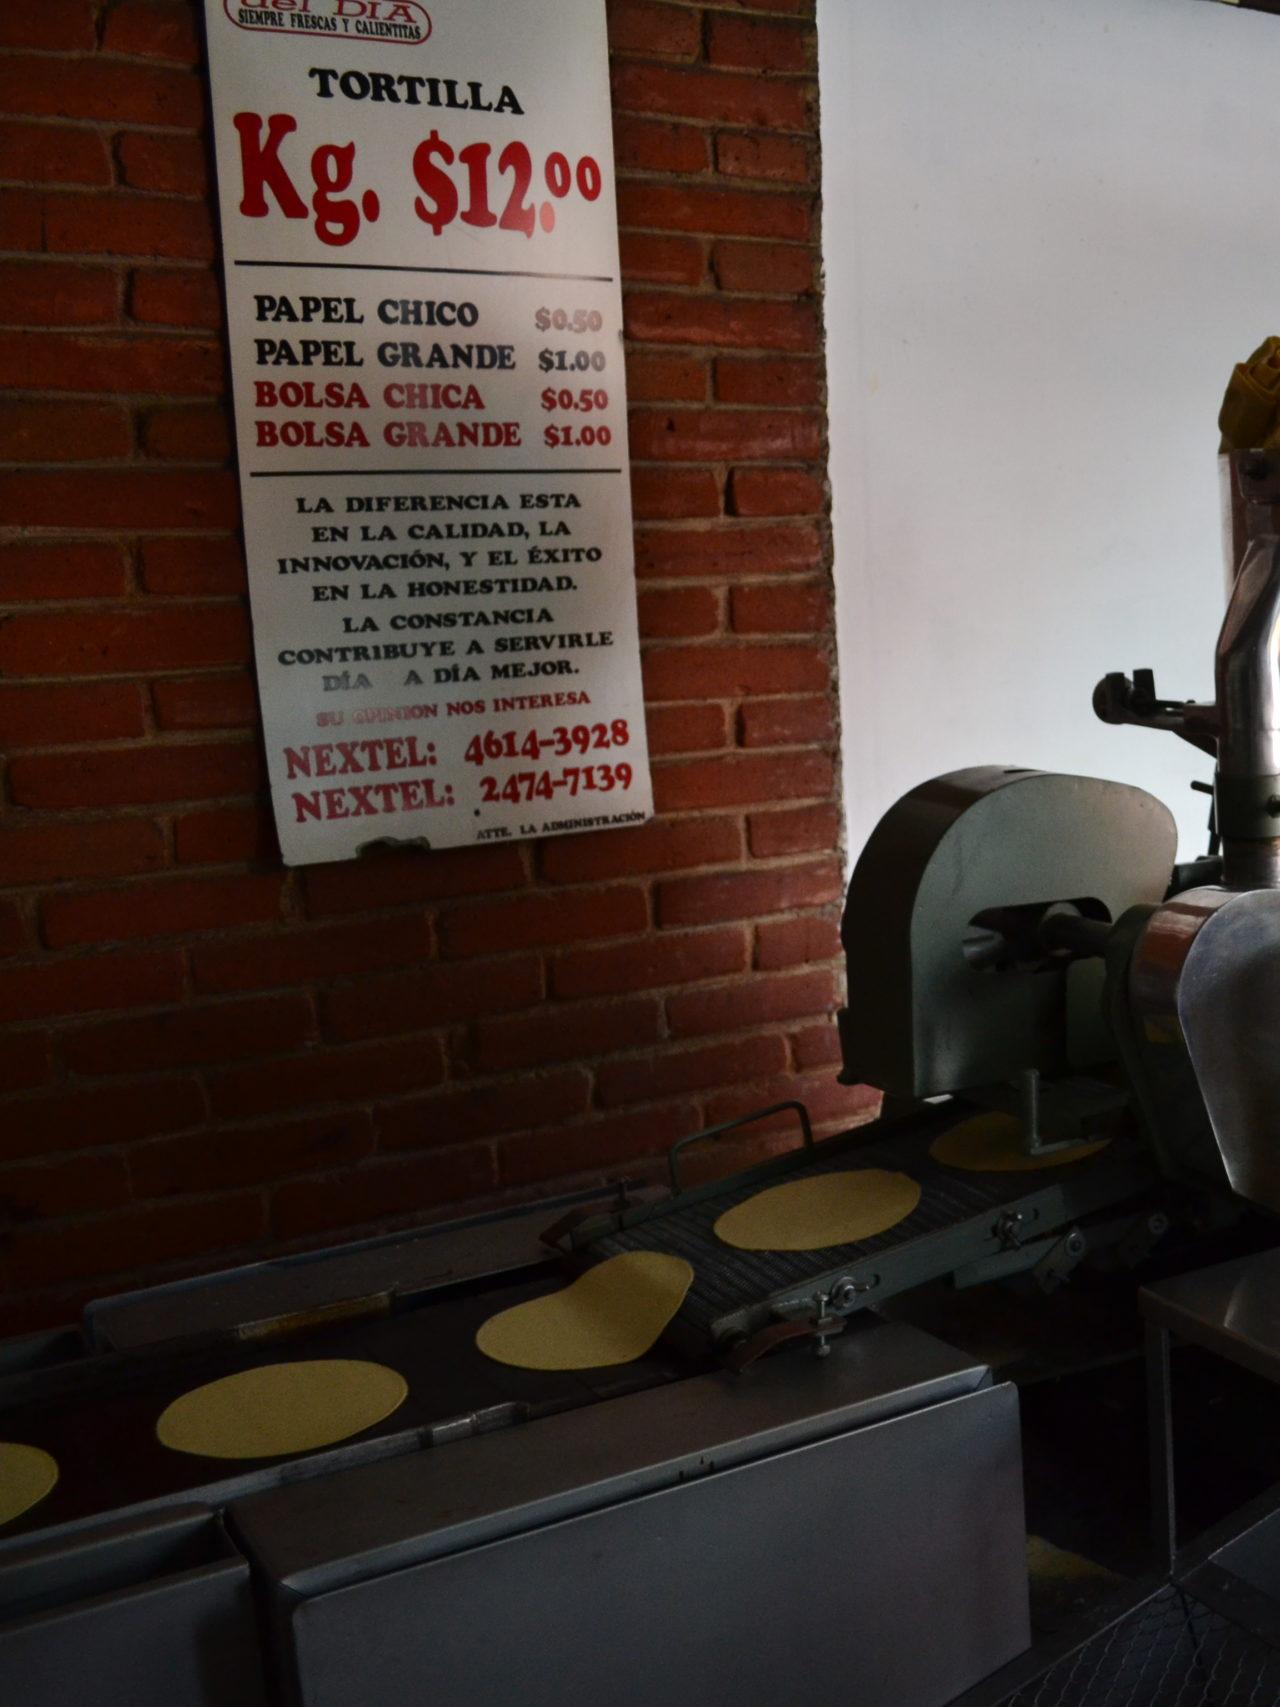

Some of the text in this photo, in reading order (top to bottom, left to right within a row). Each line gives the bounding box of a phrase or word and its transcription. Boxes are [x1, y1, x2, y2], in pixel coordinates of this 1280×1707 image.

[238, 8, 421, 40] SIEMPRE FRESCAS Y CALIENTITAS
[309, 68, 523, 114] TORTILLA
[234, 112, 600, 245] Kg. $12.00
[254, 296, 601, 332] PAPEL CHICO $0.50
[255, 340, 603, 372] PAPEL GRANDE $1.00
[255, 382, 607, 411] BOLSA CHICA $0.50
[256, 422, 610, 448] BOLSA GRANDE $1.00
[297, 494, 580, 512] LA DIFERENCIA ESTA
[312, 522, 570, 541] EN LA CALIDAD, LA
[278, 547, 601, 573] INNOVACIÓN, Y EL ÉXITO
[313, 577, 576, 600] EN LA HONESTIDAD.
[344, 609, 553, 632] LA CONSTANCIA
[278, 633, 612, 667] CONTRIBUYE A SERVIRLE
[323, 661, 578, 690] DÍA A DÍA MEJOR.
[317, 712, 343, 727] SU
[447, 701, 485, 715] NOS
[492, 690, 590, 713] INTERESA
[283, 719, 630, 779] NEXTEL: 4614-3928
[292, 763, 633, 823] NEXTEL: 2474-7139
[477, 810, 646, 840] ATTE. LA ADMINISTRACIÓN
